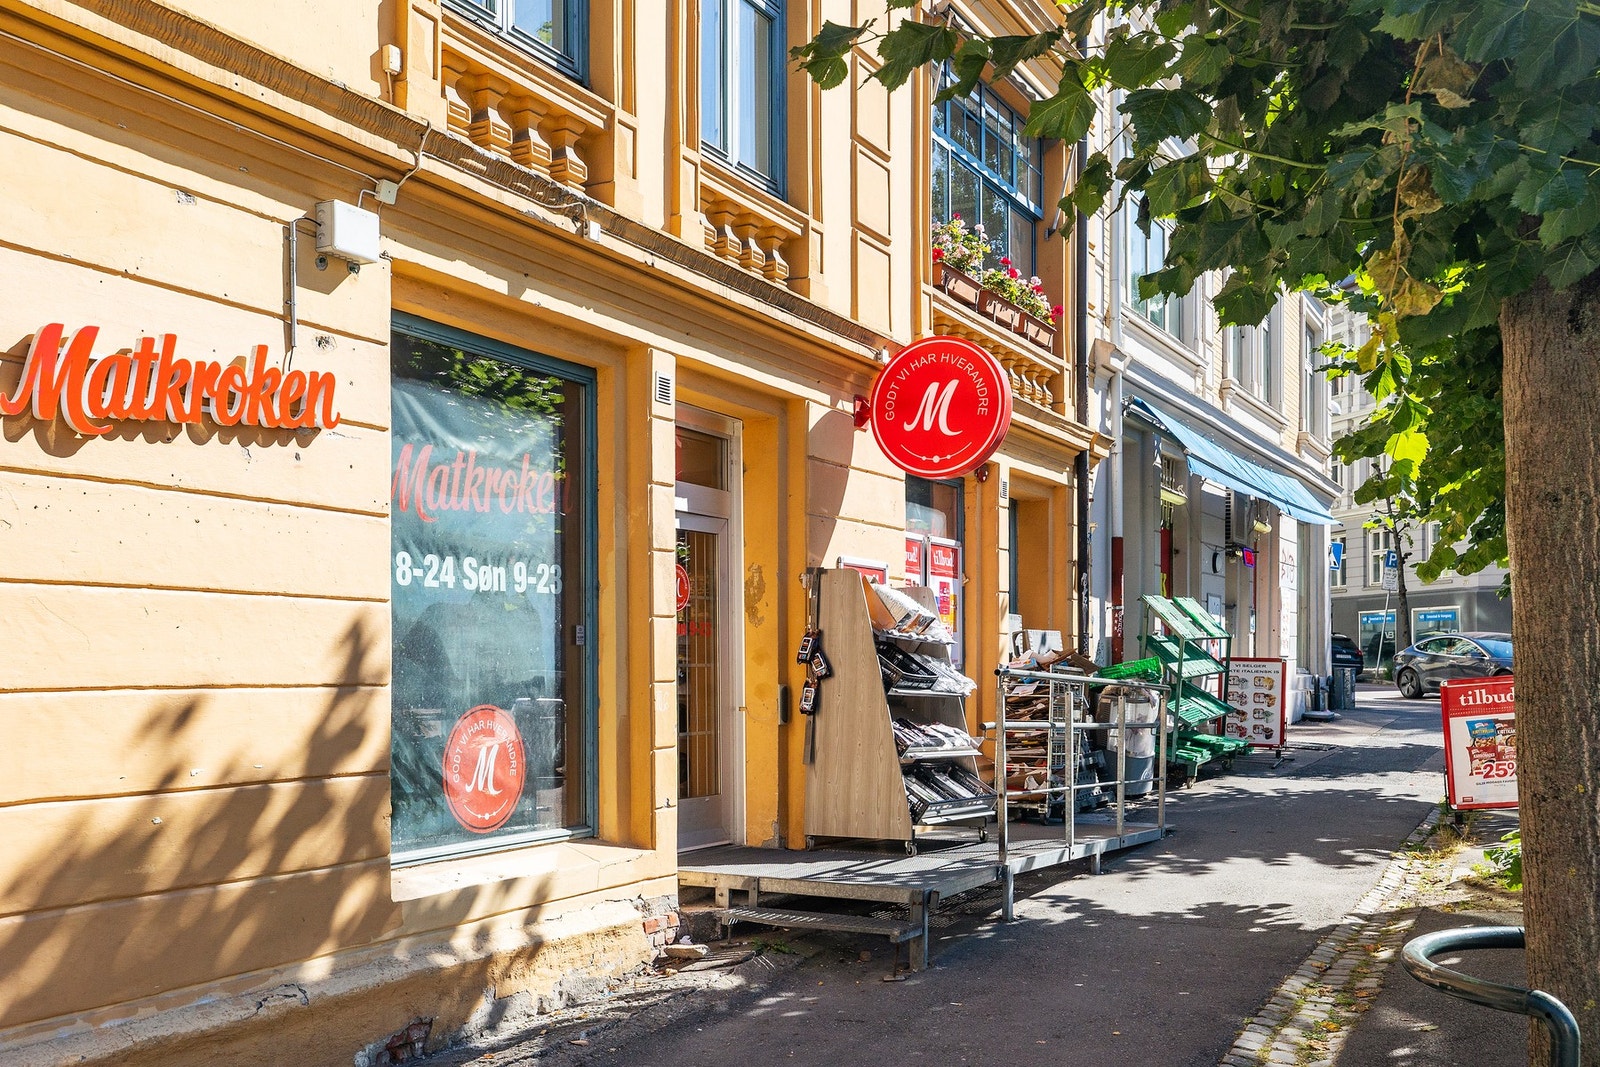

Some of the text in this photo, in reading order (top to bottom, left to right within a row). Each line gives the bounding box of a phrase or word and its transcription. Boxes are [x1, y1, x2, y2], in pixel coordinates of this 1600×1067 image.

[0, 322, 341, 435] Matkroken
[884, 352, 989, 421] GODT VI HAR HVERANDRE
[903, 379, 964, 437] M
[391, 443, 574, 523] Matkroken
[395, 551, 563, 595] 8-24 Søn 9-23
[1388, 552, 1397, 566] P
[452, 719, 517, 783] GODT VI HAR HVERANDRE
[465, 743, 504, 796] M
